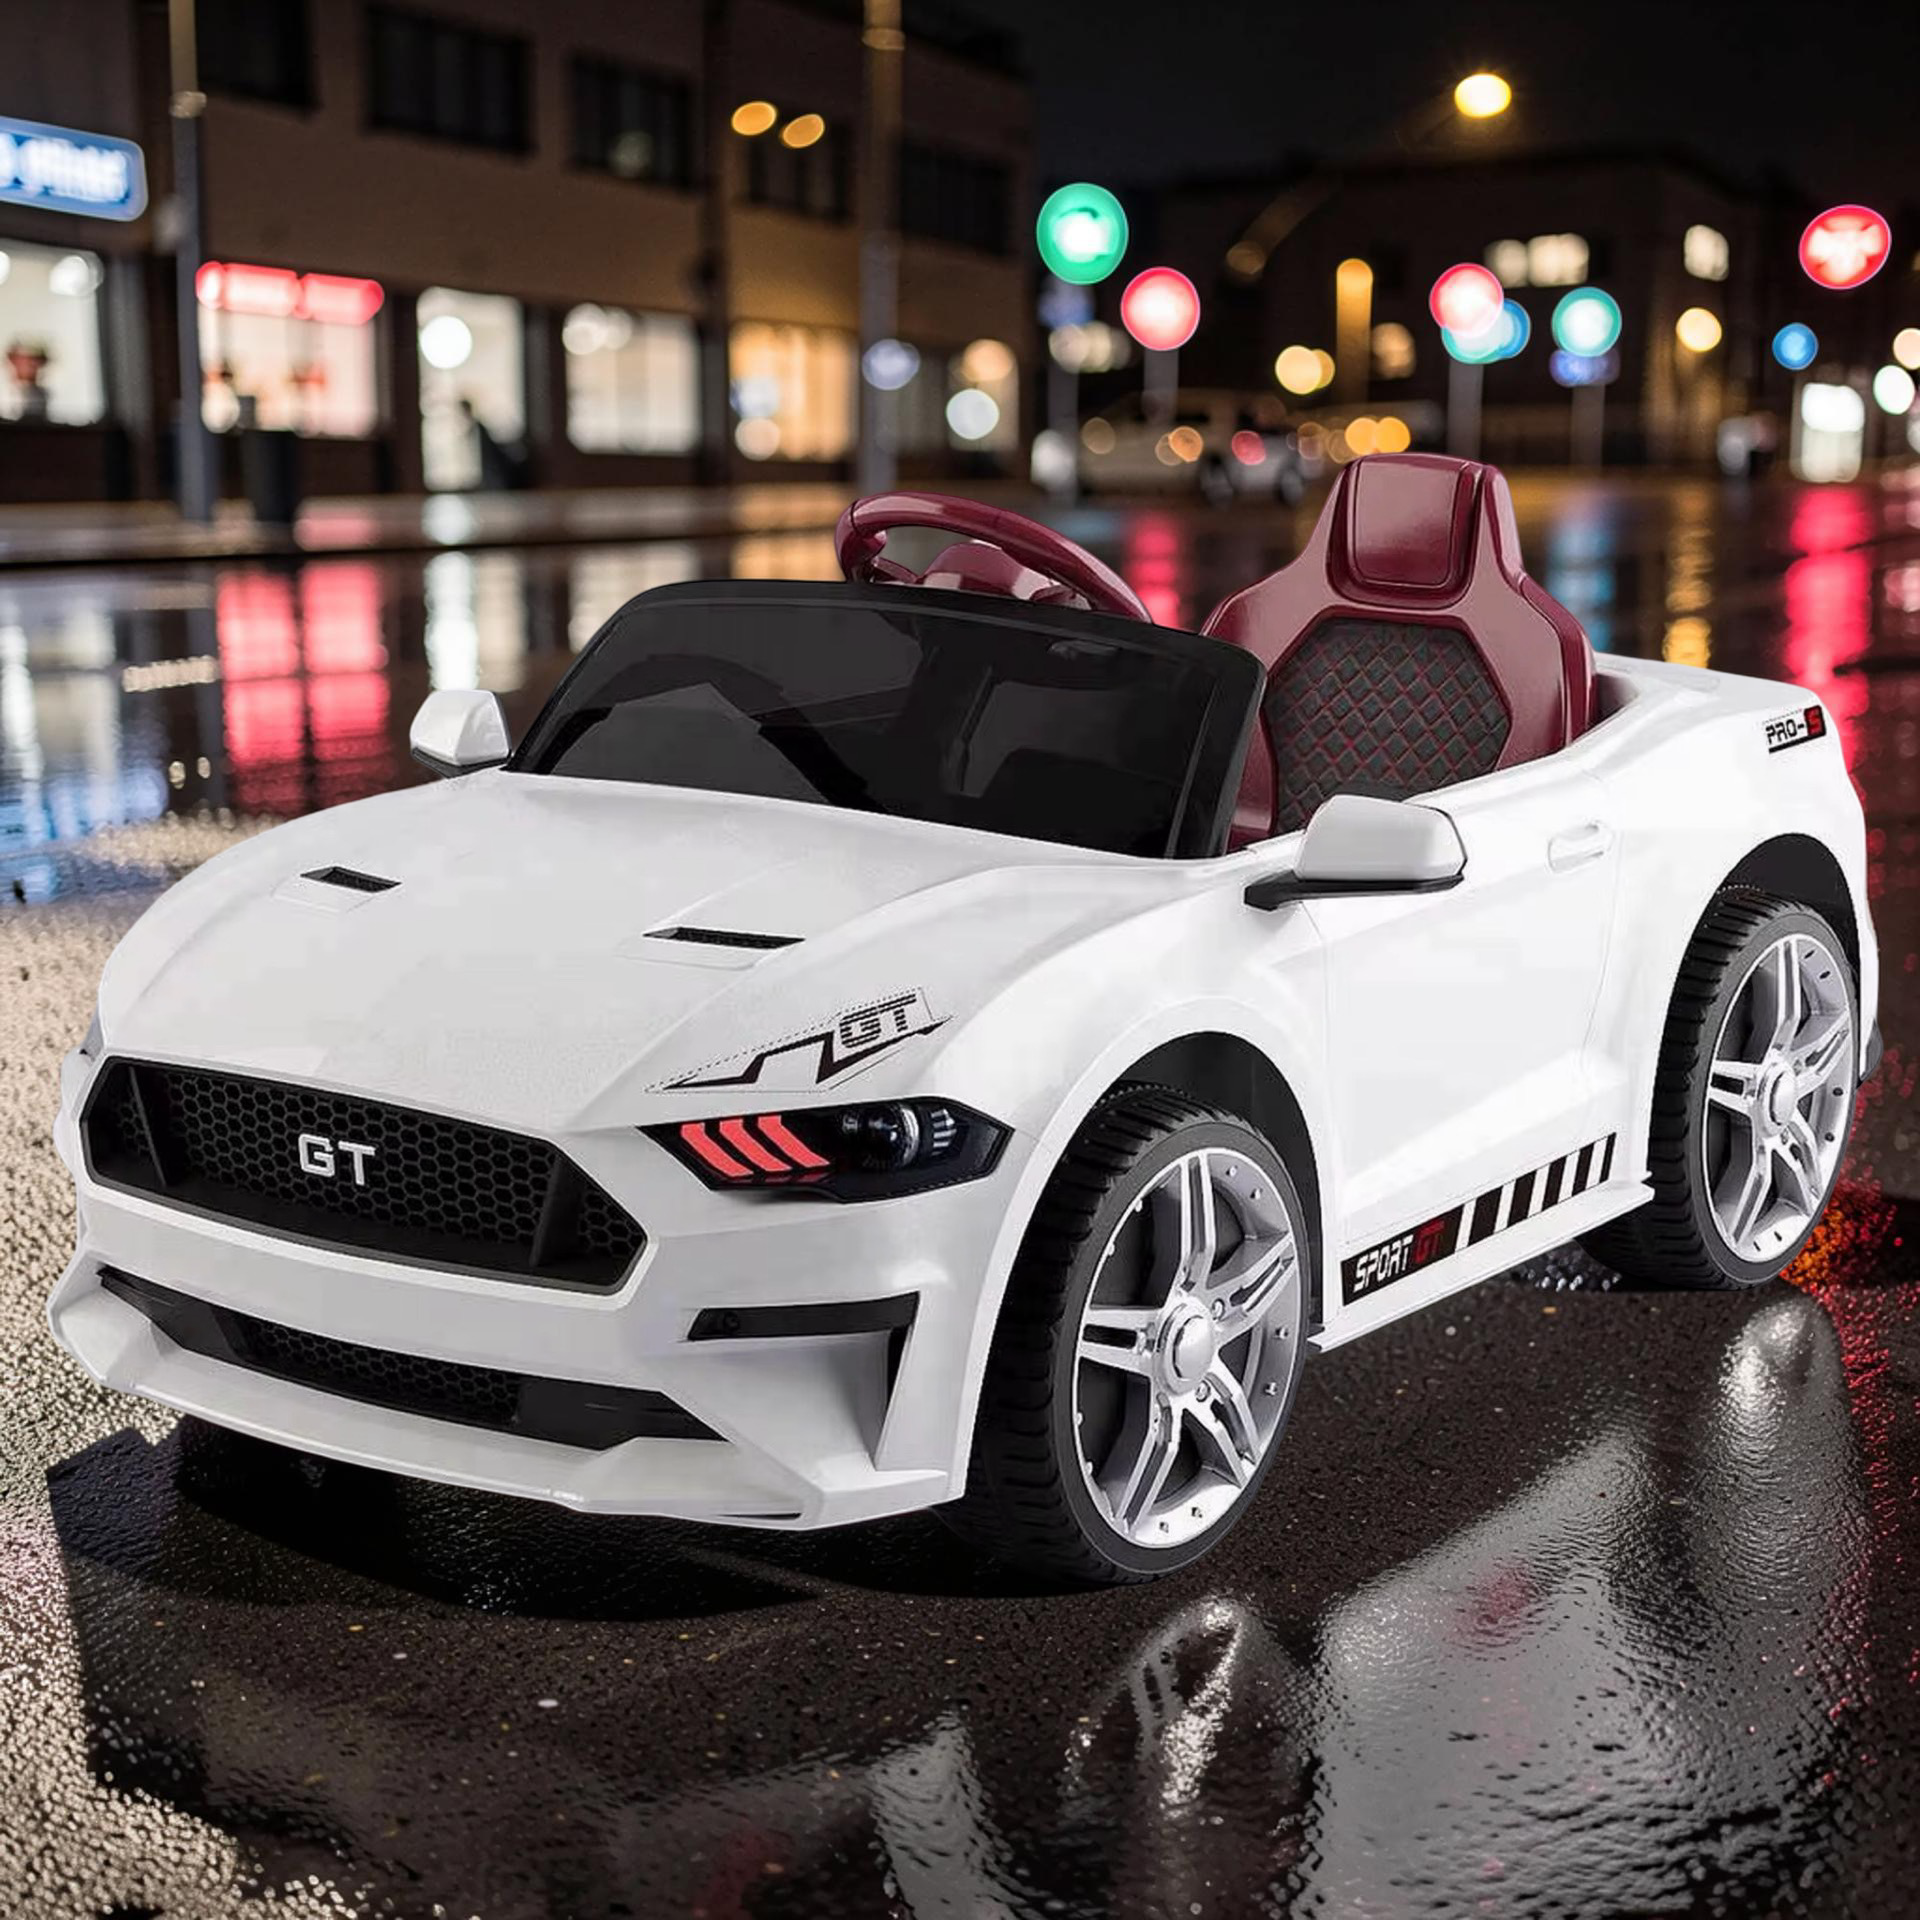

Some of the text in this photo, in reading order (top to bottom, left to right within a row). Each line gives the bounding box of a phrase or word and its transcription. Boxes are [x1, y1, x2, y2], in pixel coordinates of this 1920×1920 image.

[840, 993, 917, 1048] GT
[298, 1133, 376, 1186] GT
[1353, 1234, 1415, 1293] SPORT
